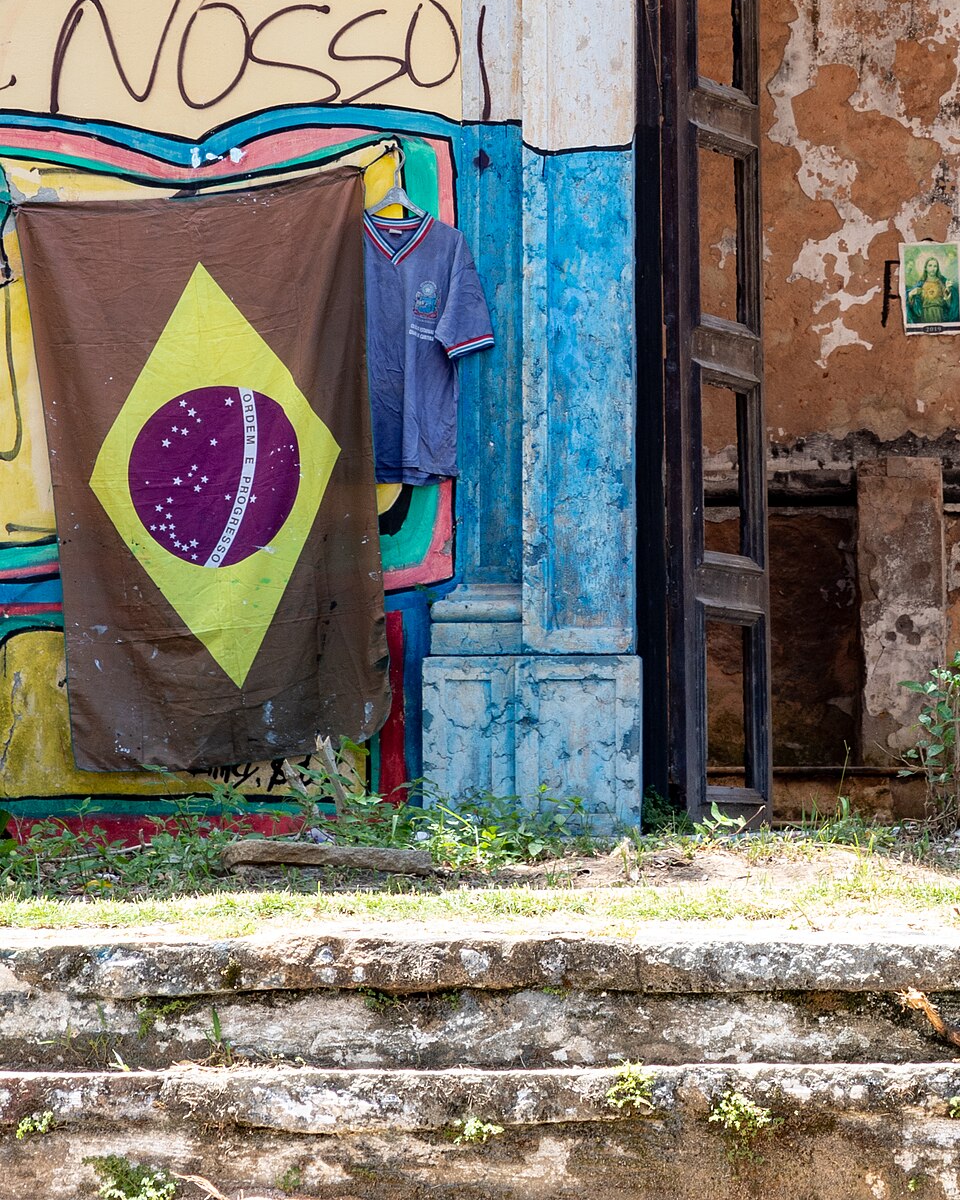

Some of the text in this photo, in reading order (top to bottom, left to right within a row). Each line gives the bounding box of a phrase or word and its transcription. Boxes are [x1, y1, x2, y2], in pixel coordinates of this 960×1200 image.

[210, 393, 256, 564] ORDEM E PROGRESSO
